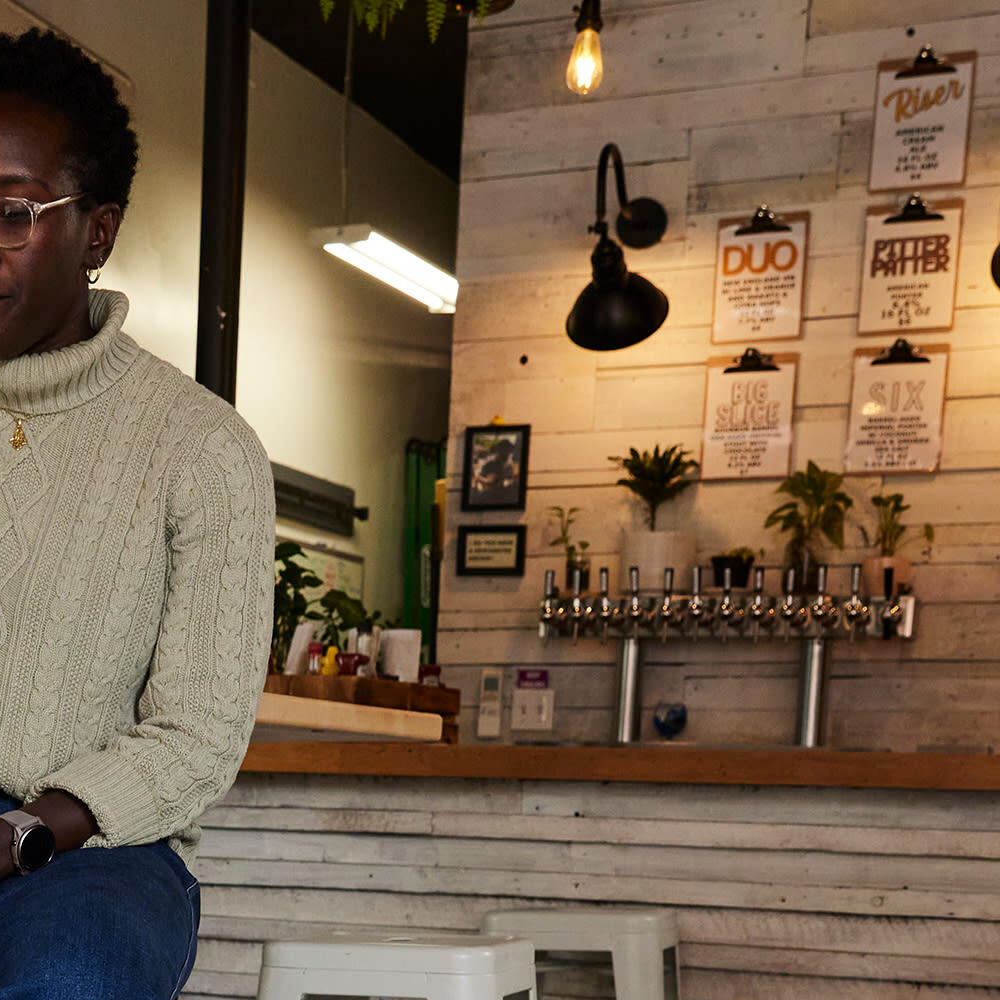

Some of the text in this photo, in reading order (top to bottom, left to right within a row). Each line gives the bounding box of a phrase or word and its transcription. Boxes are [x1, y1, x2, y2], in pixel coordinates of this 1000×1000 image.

[882, 80, 965, 122] Riser
[722, 239, 798, 276] DUO
[874, 234, 951, 259] PITTER
[870, 254, 951, 277] PATTER
[731, 379, 769, 406] BIG
[867, 380, 926, 413] SIX
[715, 402, 782, 428] SLICE
